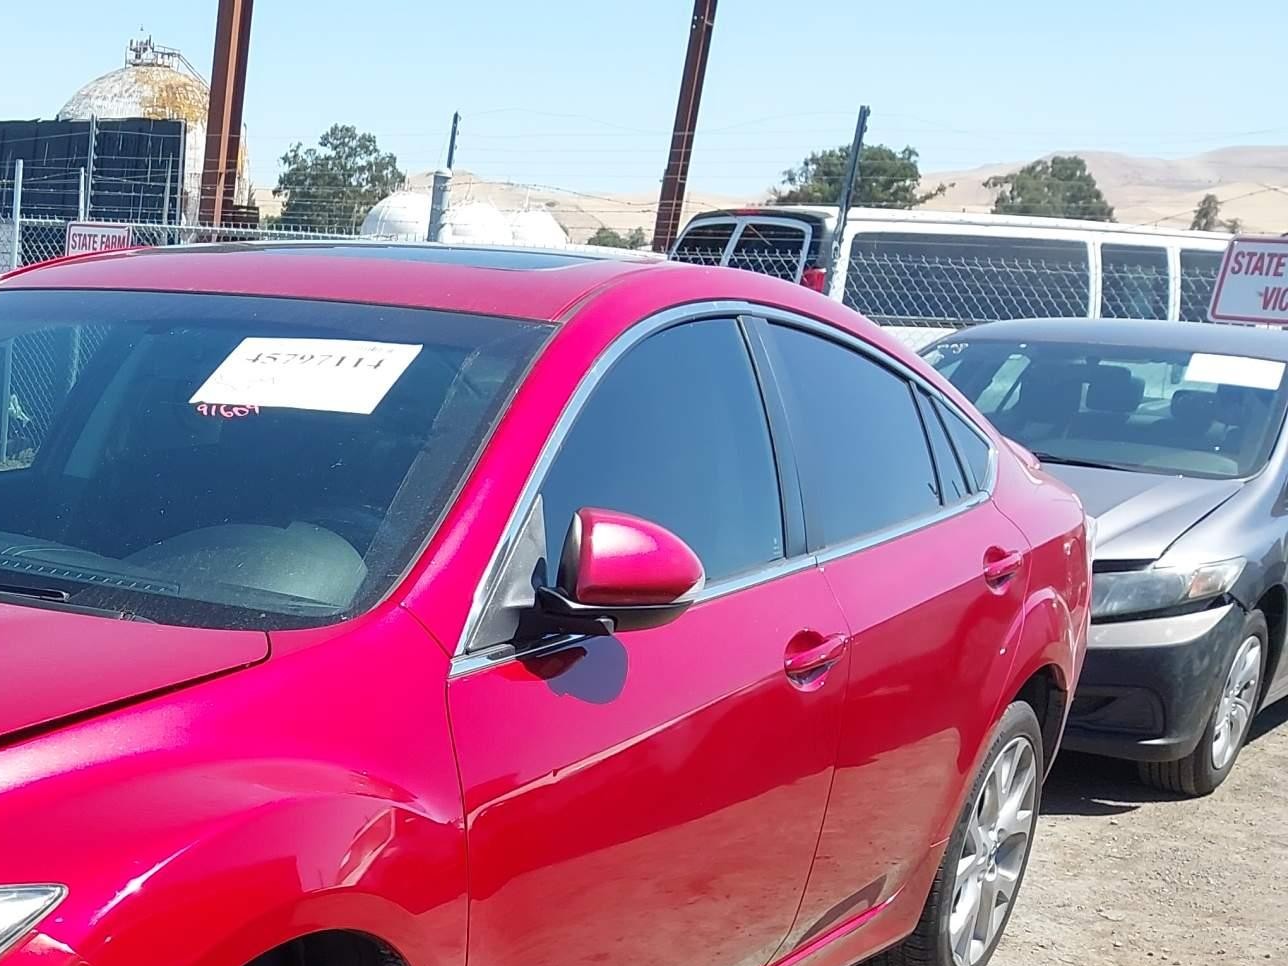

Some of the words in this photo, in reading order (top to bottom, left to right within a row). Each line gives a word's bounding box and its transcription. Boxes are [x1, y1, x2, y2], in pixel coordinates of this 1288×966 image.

[72, 233, 98, 251] STATE
[99, 234, 127, 250] FARM
[1230, 251, 1288, 277] STATE
[246, 352, 385, 371] 45797114
